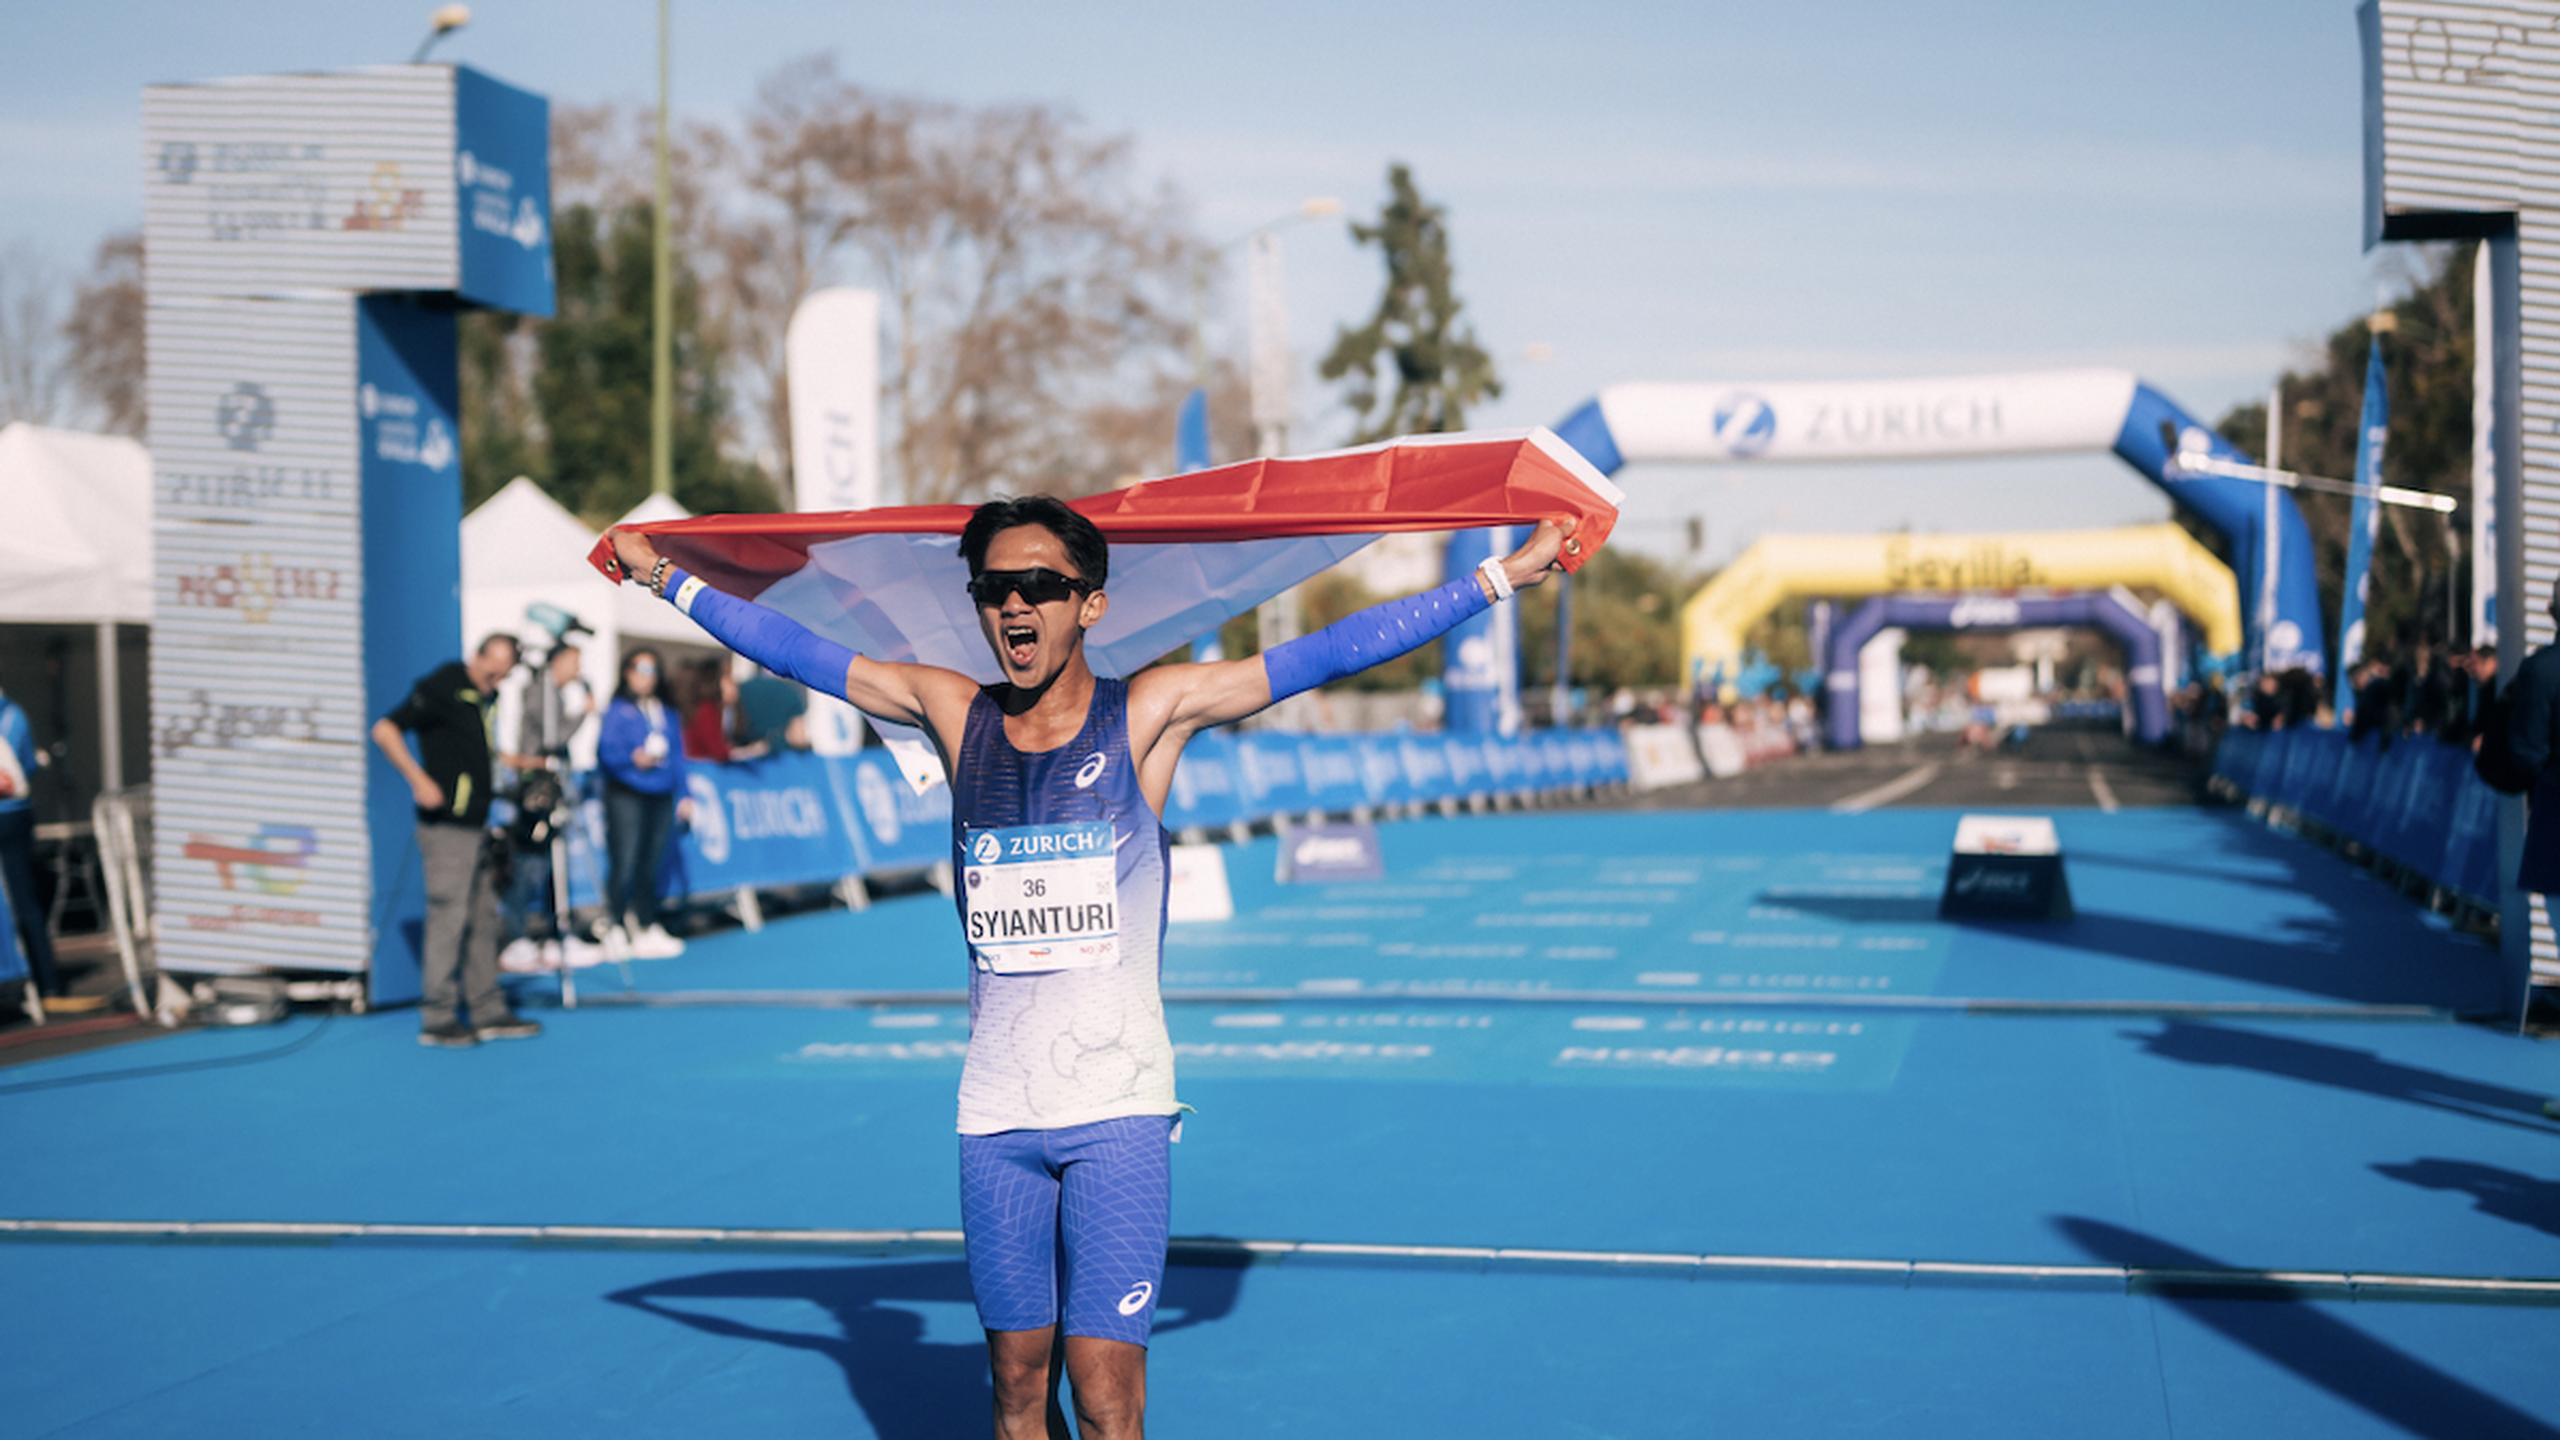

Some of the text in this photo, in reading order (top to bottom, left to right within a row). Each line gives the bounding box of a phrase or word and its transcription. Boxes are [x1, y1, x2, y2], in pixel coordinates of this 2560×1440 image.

[1803, 397, 2003, 442] ZURICH
[1010, 832, 1094, 855] ZURICH
[1023, 878, 1046, 897] 36
[971, 903, 1113, 939] SYIANTURI
